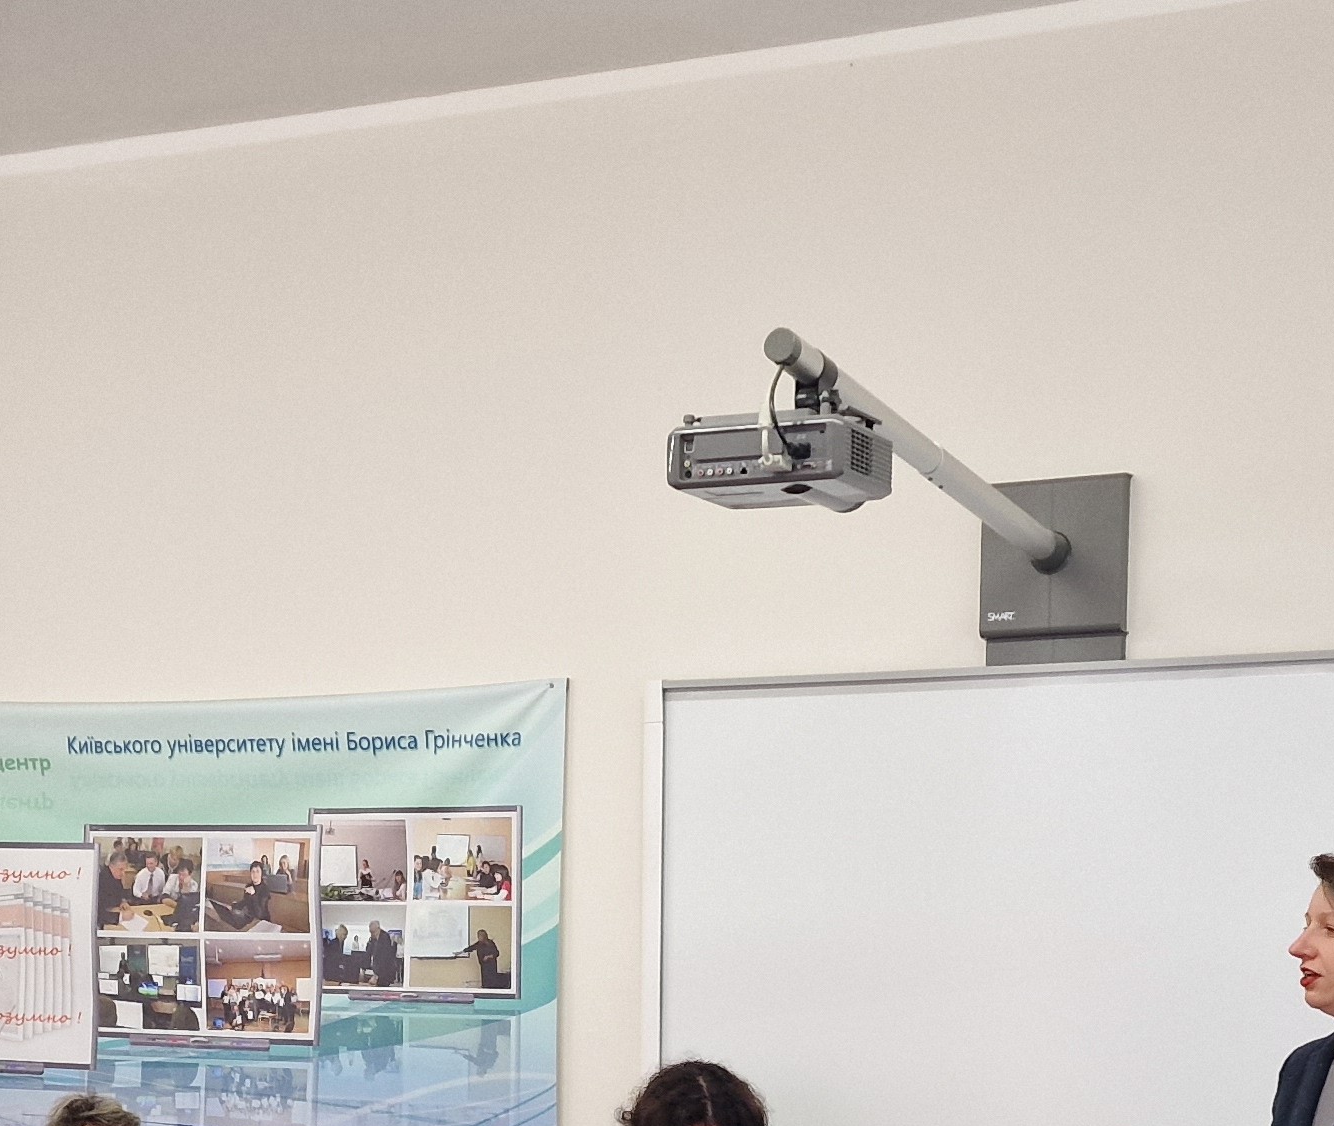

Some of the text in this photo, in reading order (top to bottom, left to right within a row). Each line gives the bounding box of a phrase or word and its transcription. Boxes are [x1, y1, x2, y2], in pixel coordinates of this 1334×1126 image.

[987, 611, 1016, 622] SMART
[67, 729, 521, 759] Київського університету імені Бориса Грінченка
